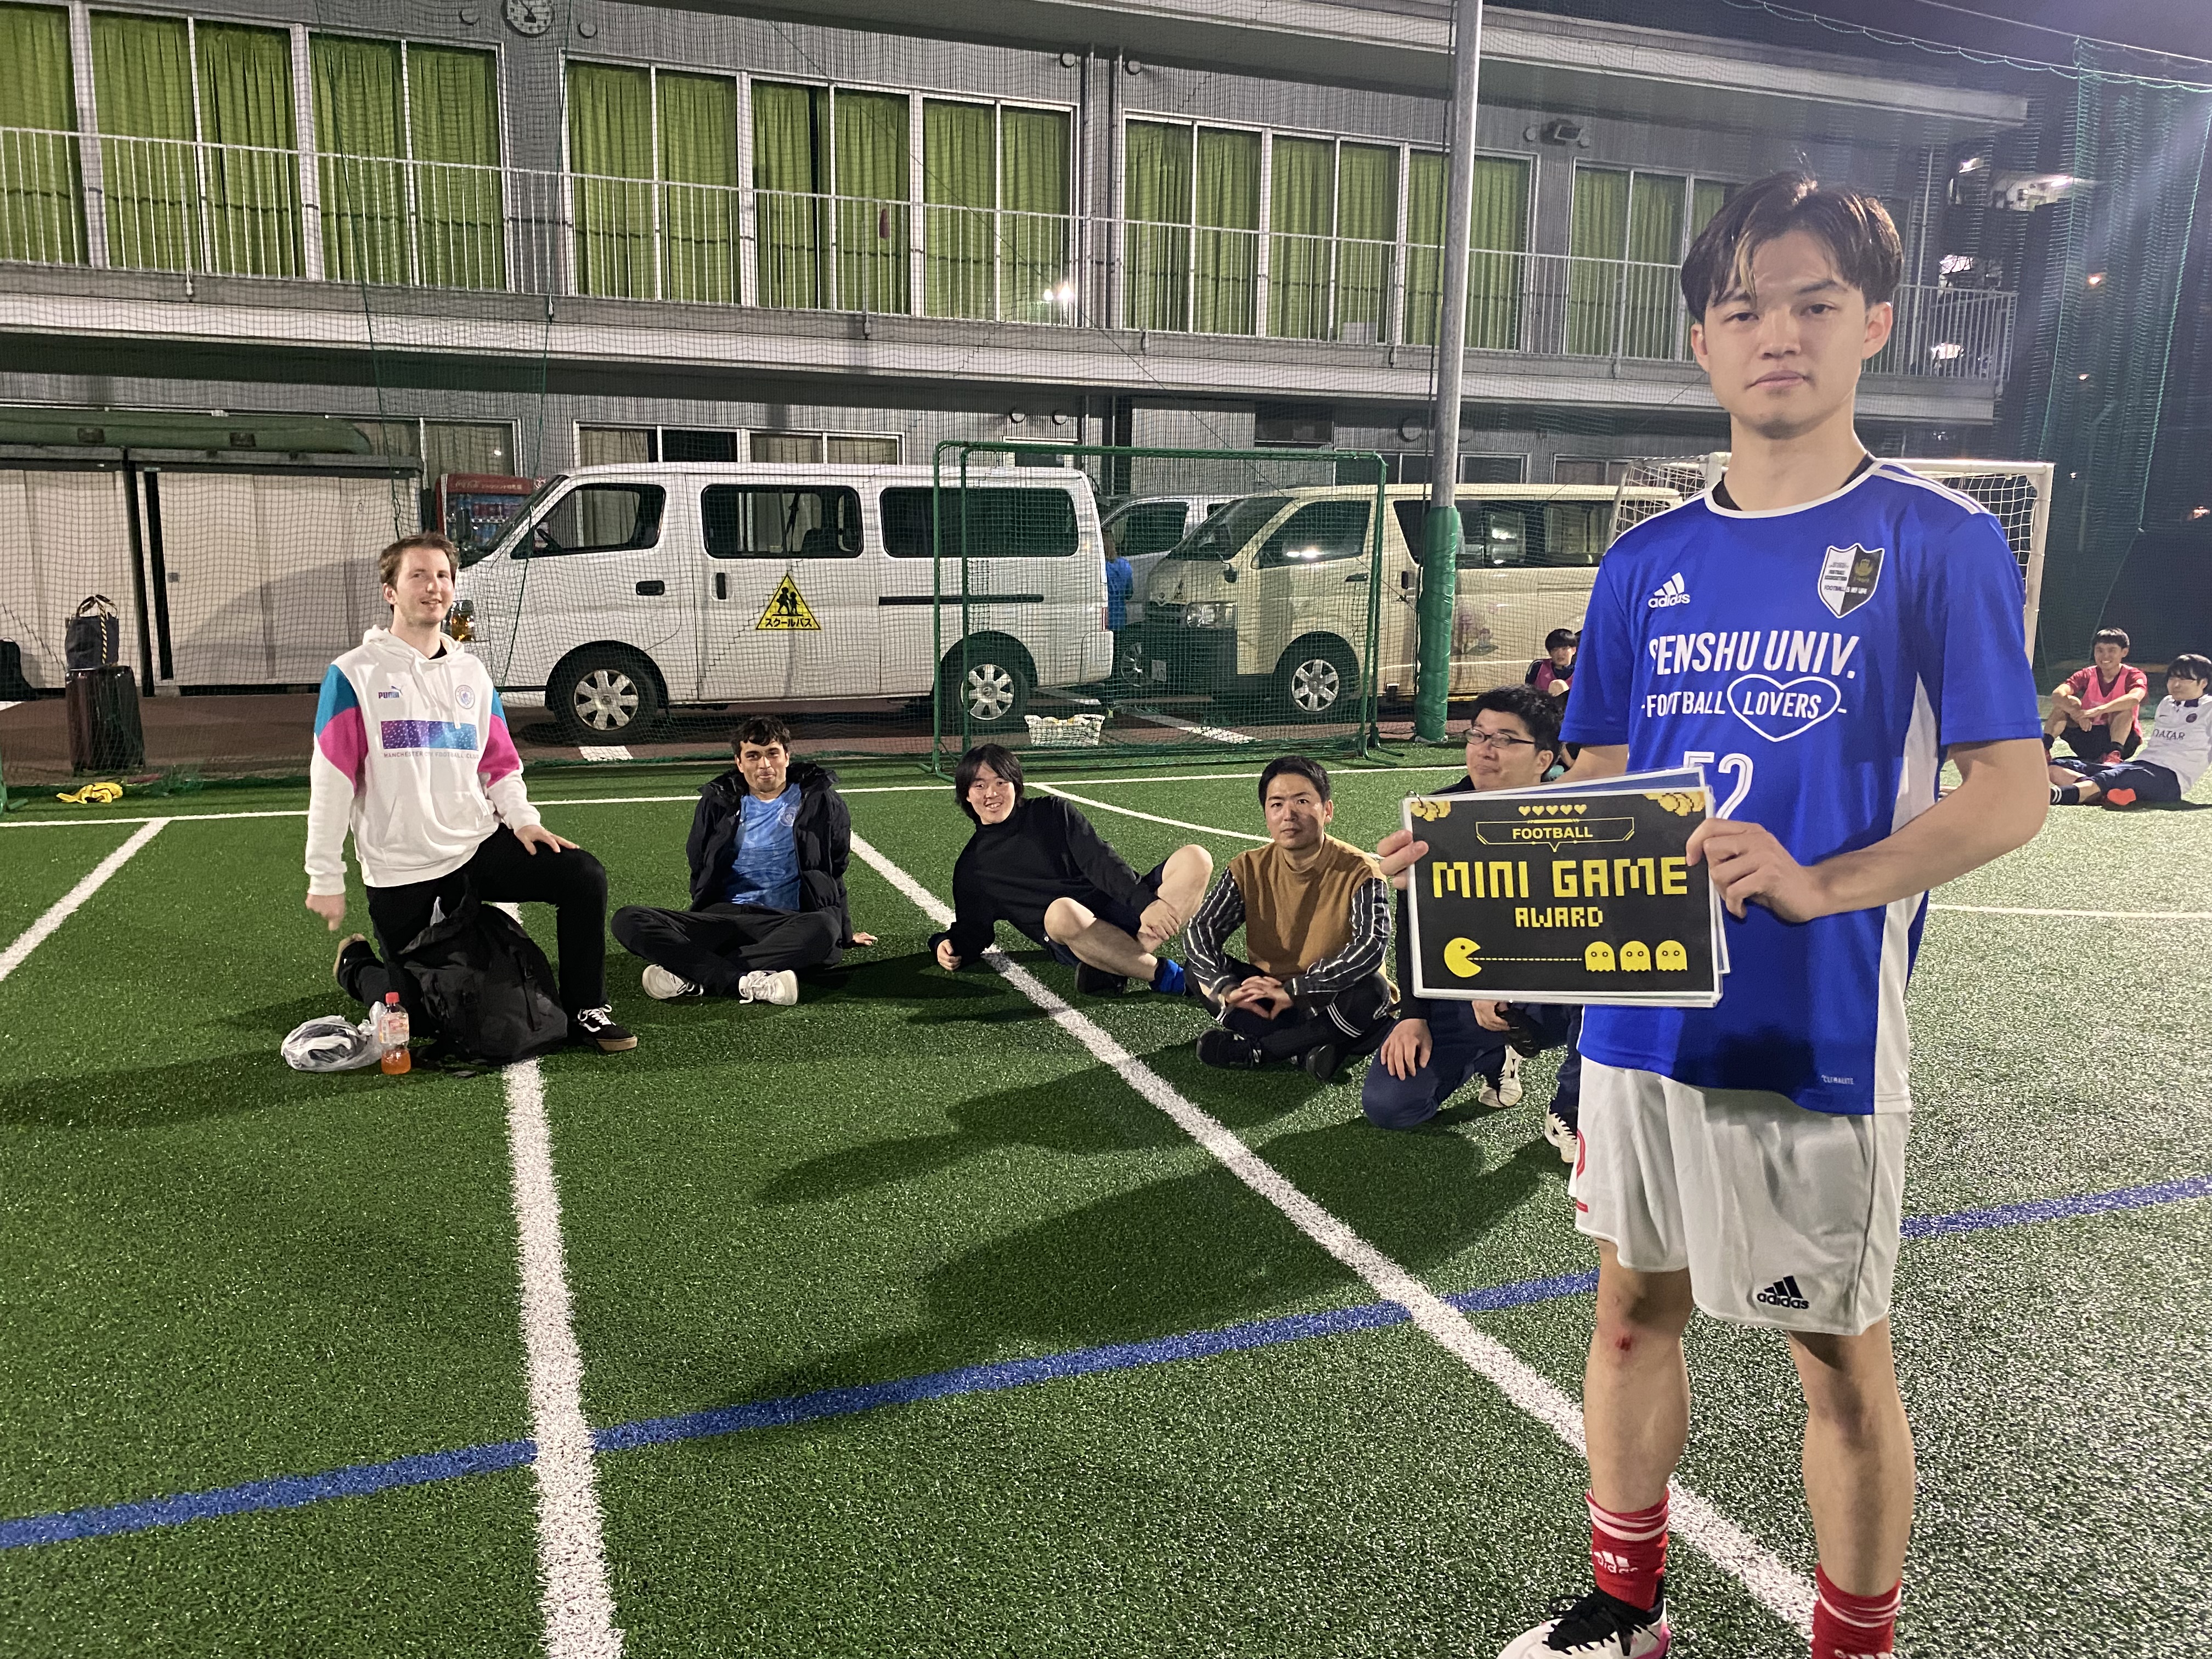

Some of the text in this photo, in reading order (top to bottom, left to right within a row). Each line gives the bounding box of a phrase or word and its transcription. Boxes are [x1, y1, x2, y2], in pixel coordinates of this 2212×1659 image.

[1647, 594, 1691, 608] adidas
[765, 618, 812, 627] スクールバス
[1763, 630, 1860, 679] UNIV.
[1742, 691, 1822, 719] LOVERS
[1512, 826, 1593, 839] FOOTBALL
[1432, 856, 1688, 899] MINI GAME
[1515, 906, 1604, 928] AWARD
[1757, 1292, 1810, 1310] adidas
